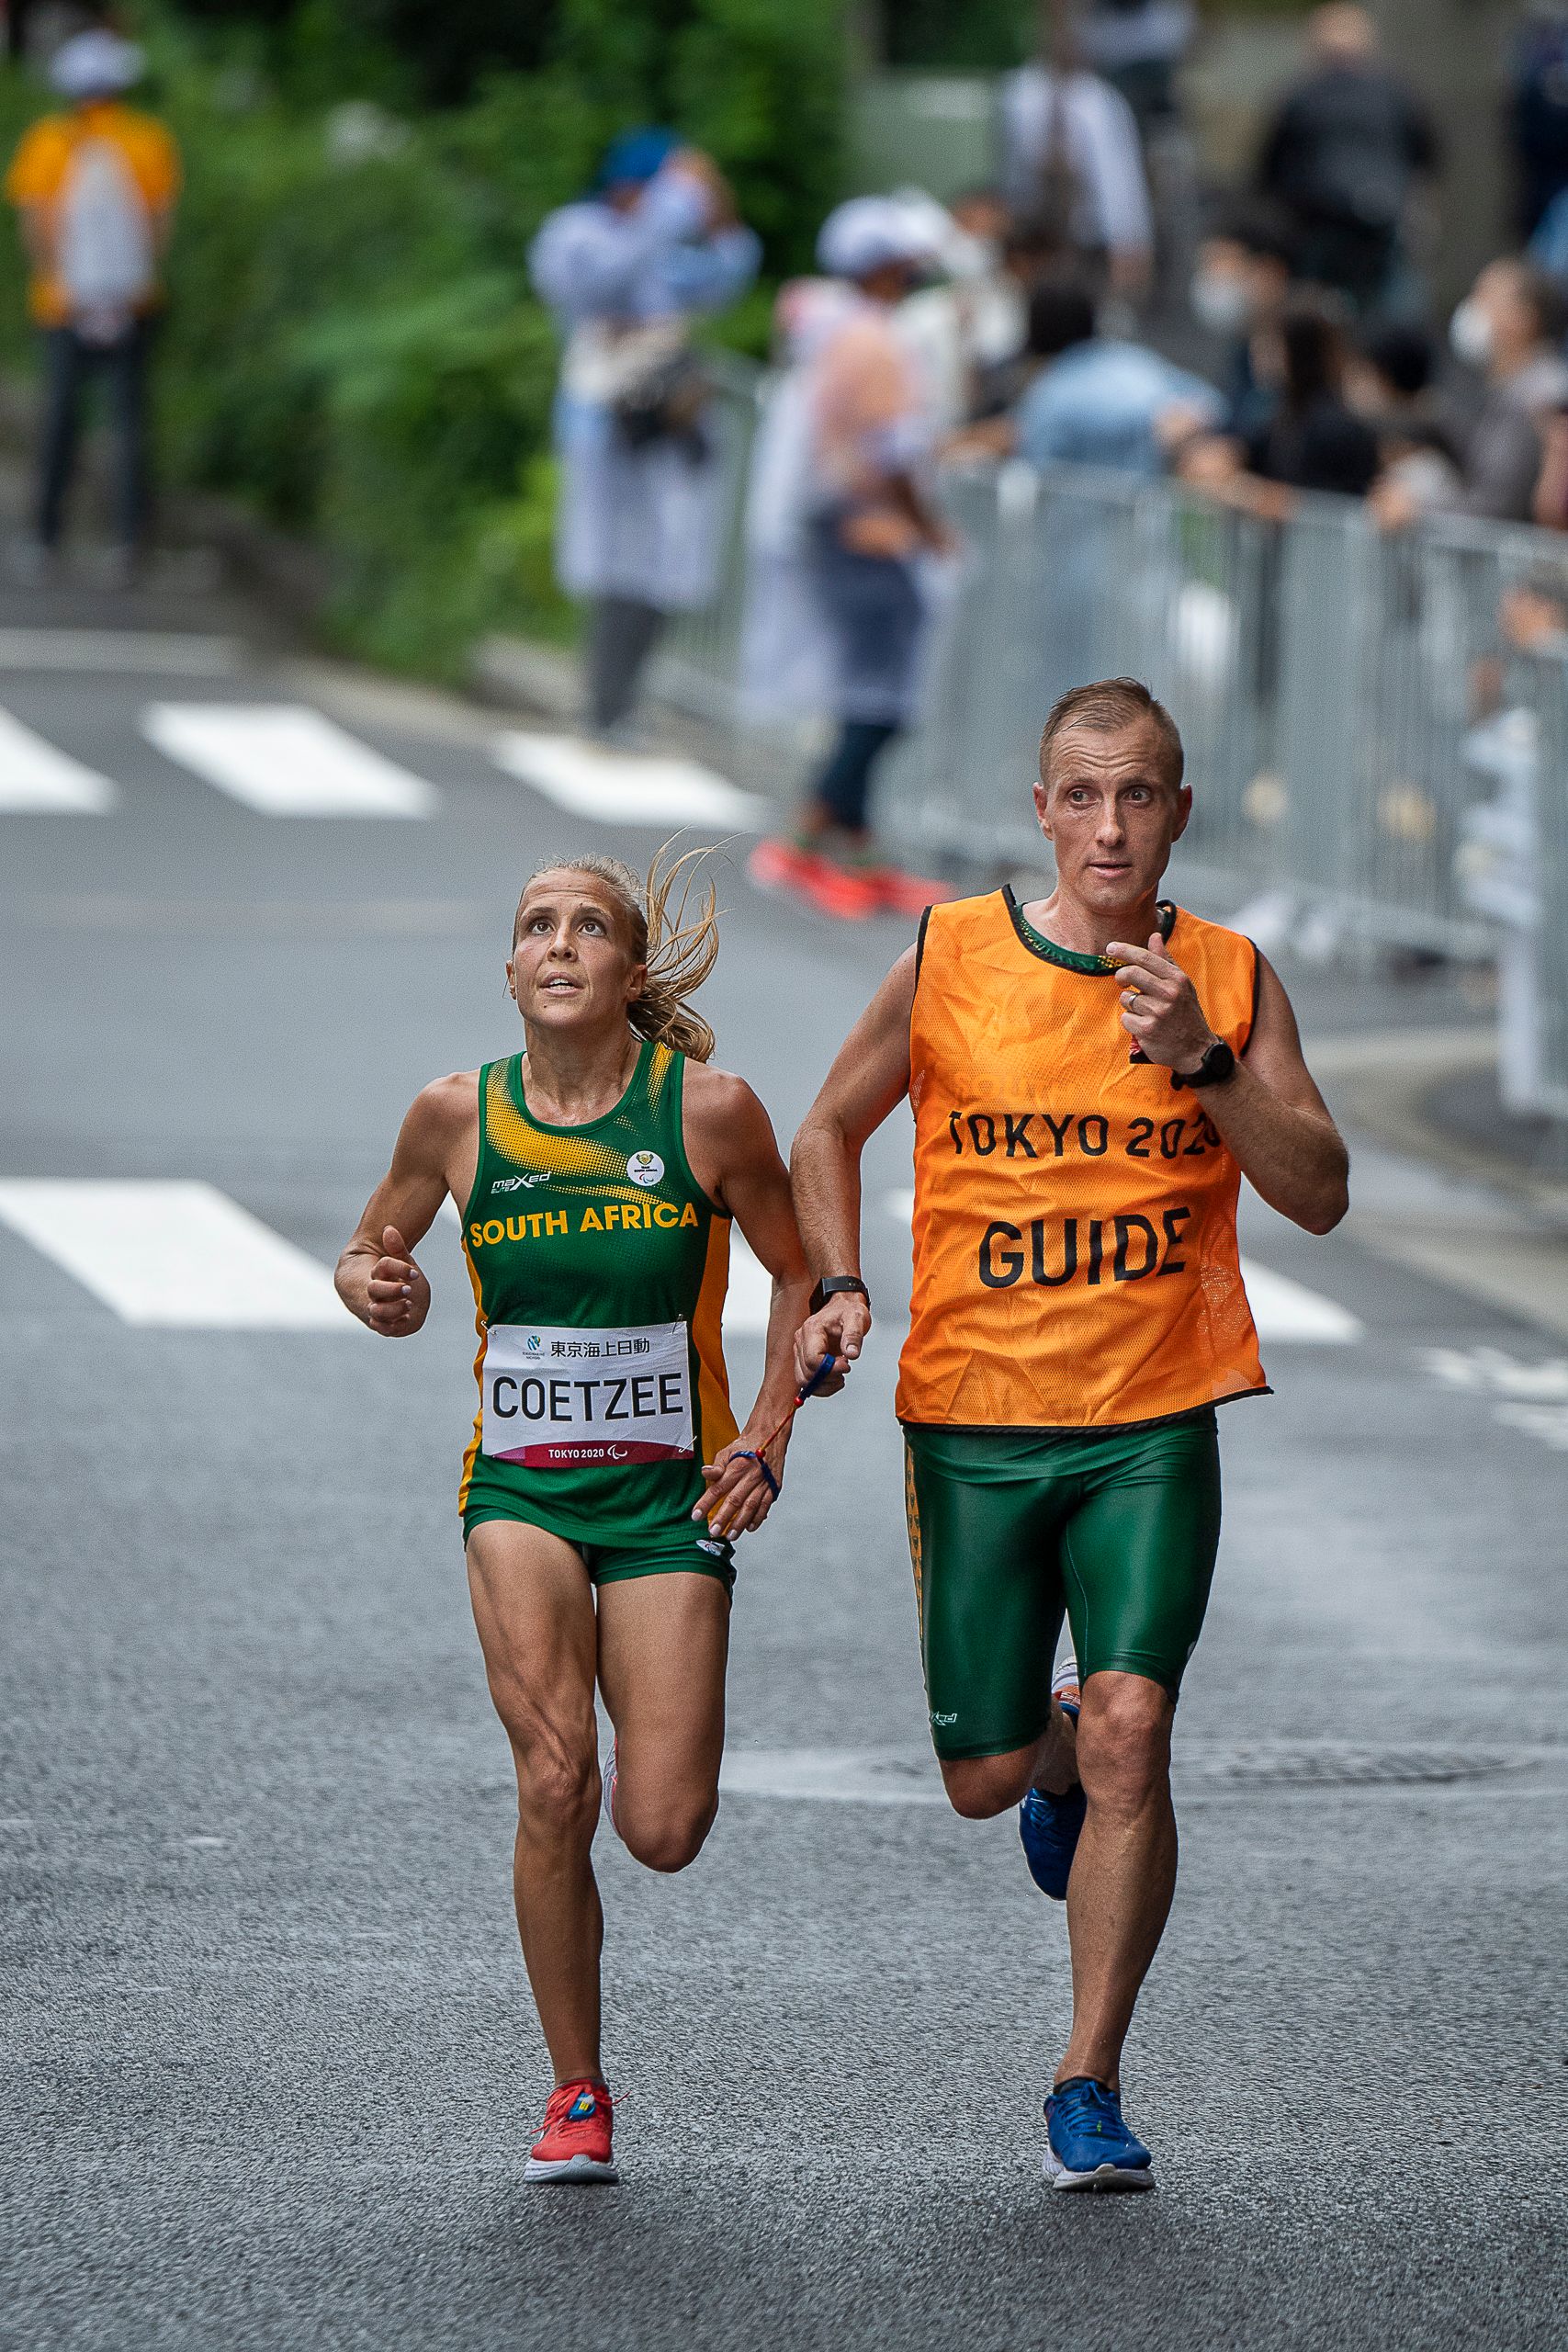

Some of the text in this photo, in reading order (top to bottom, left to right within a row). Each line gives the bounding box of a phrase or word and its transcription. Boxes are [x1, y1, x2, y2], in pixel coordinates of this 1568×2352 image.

[949, 1111, 1221, 1159] TOKYO 2020
[469, 1203, 699, 1248] SOUTH AFRICA
[978, 1206, 1191, 1288] GUIDE
[550, 1337, 650, 1358] 東京海上日動
[491, 1372, 684, 1422] COETZEE
[547, 1448, 604, 1459] TOKYO 2020
